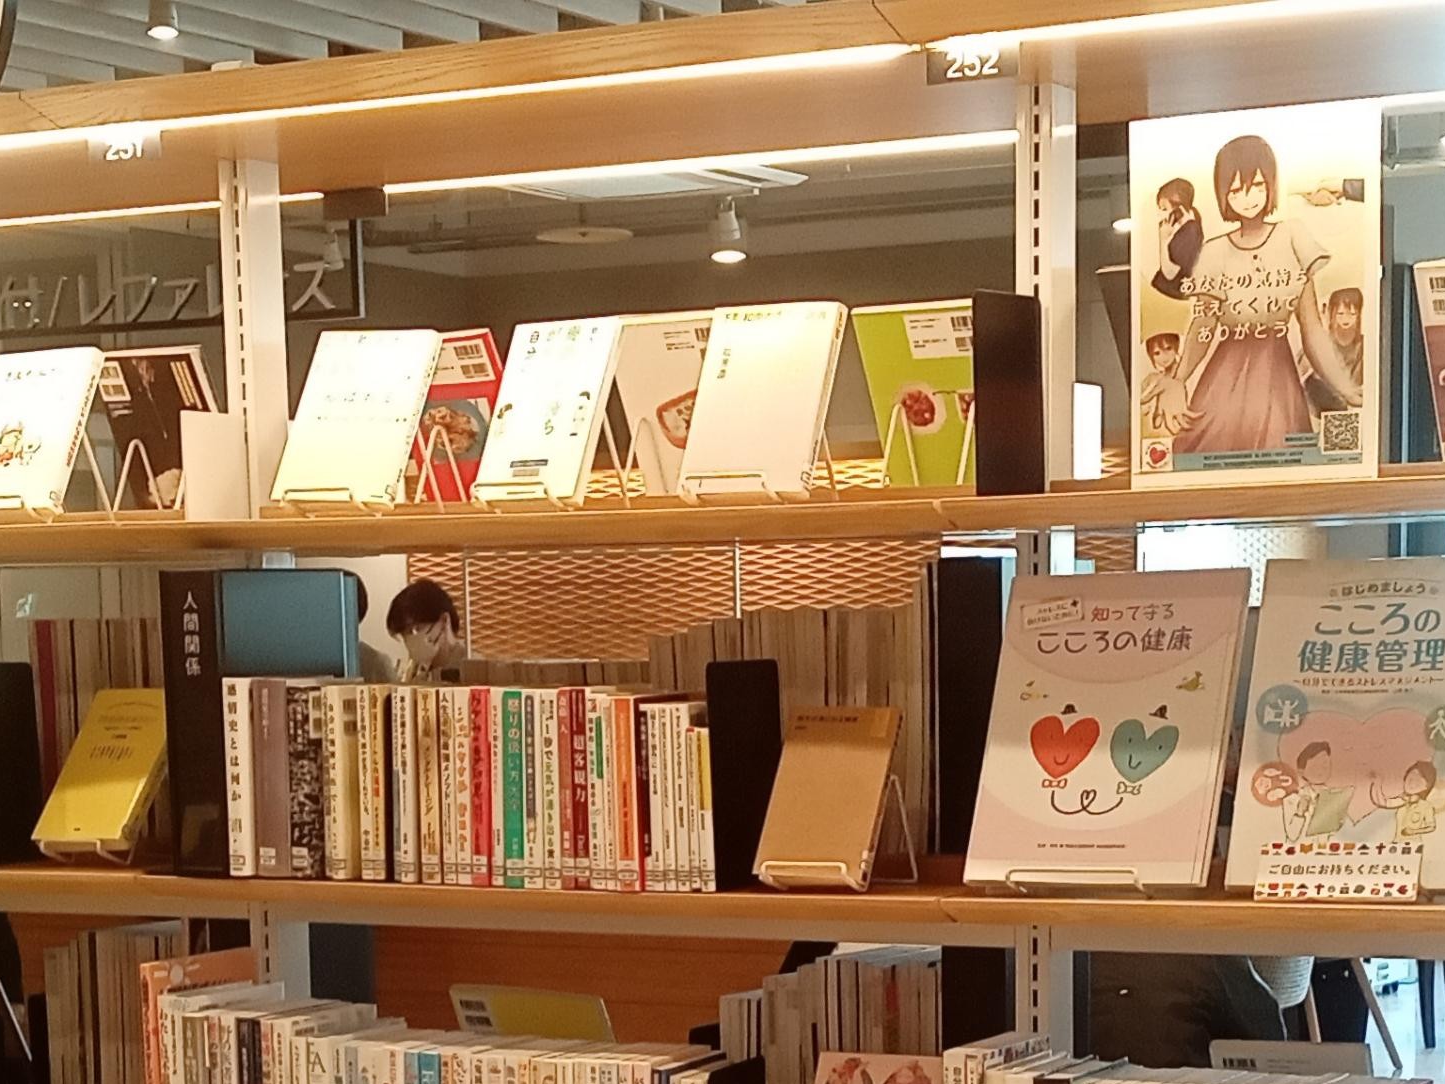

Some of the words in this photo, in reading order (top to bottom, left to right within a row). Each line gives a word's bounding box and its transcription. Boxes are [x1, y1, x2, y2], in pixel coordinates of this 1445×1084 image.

[946, 48, 1000, 78] 252
[1179, 268, 1309, 296] あなたの気持ち
[1190, 294, 1299, 319] 伝えてくれて
[1196, 319, 1290, 342] ありがとう
[1340, 581, 1429, 597] はじめましょう
[1090, 603, 1176, 622] 知って守る
[1313, 602, 1443, 636] こころの
[182, 589, 202, 678] 人間関係
[1036, 625, 1194, 655] こころの健康
[1268, 862, 1412, 878] ご自由にお持ちください。
